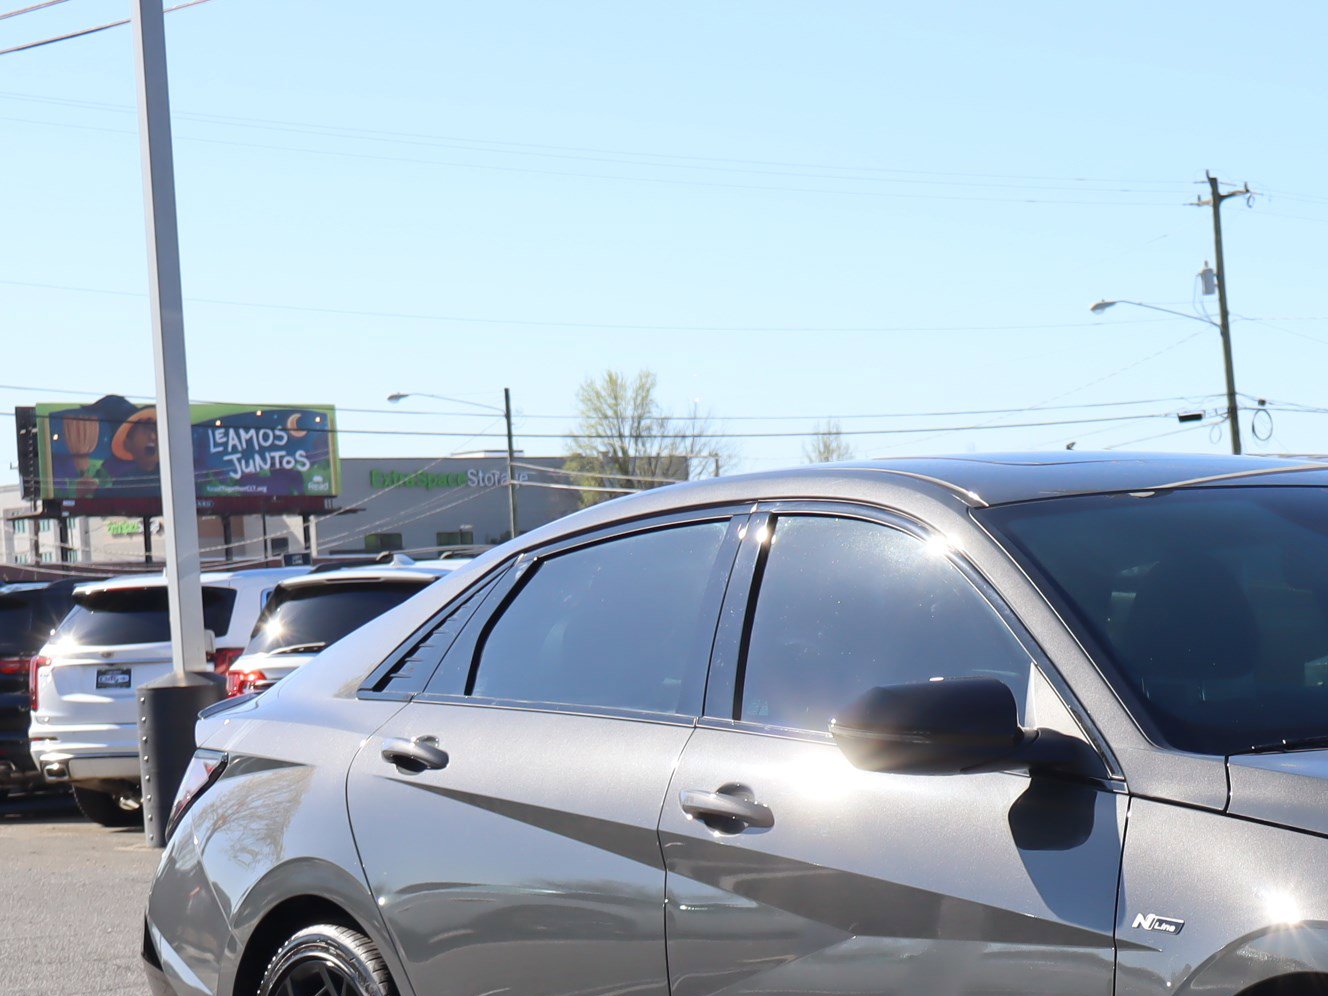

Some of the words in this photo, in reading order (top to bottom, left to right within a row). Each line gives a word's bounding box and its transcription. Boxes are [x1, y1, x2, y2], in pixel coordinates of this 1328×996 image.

[208, 426, 288, 454] LEAMOS
[1132, 912, 1156, 931] N
[1154, 922, 1176, 932] Line
